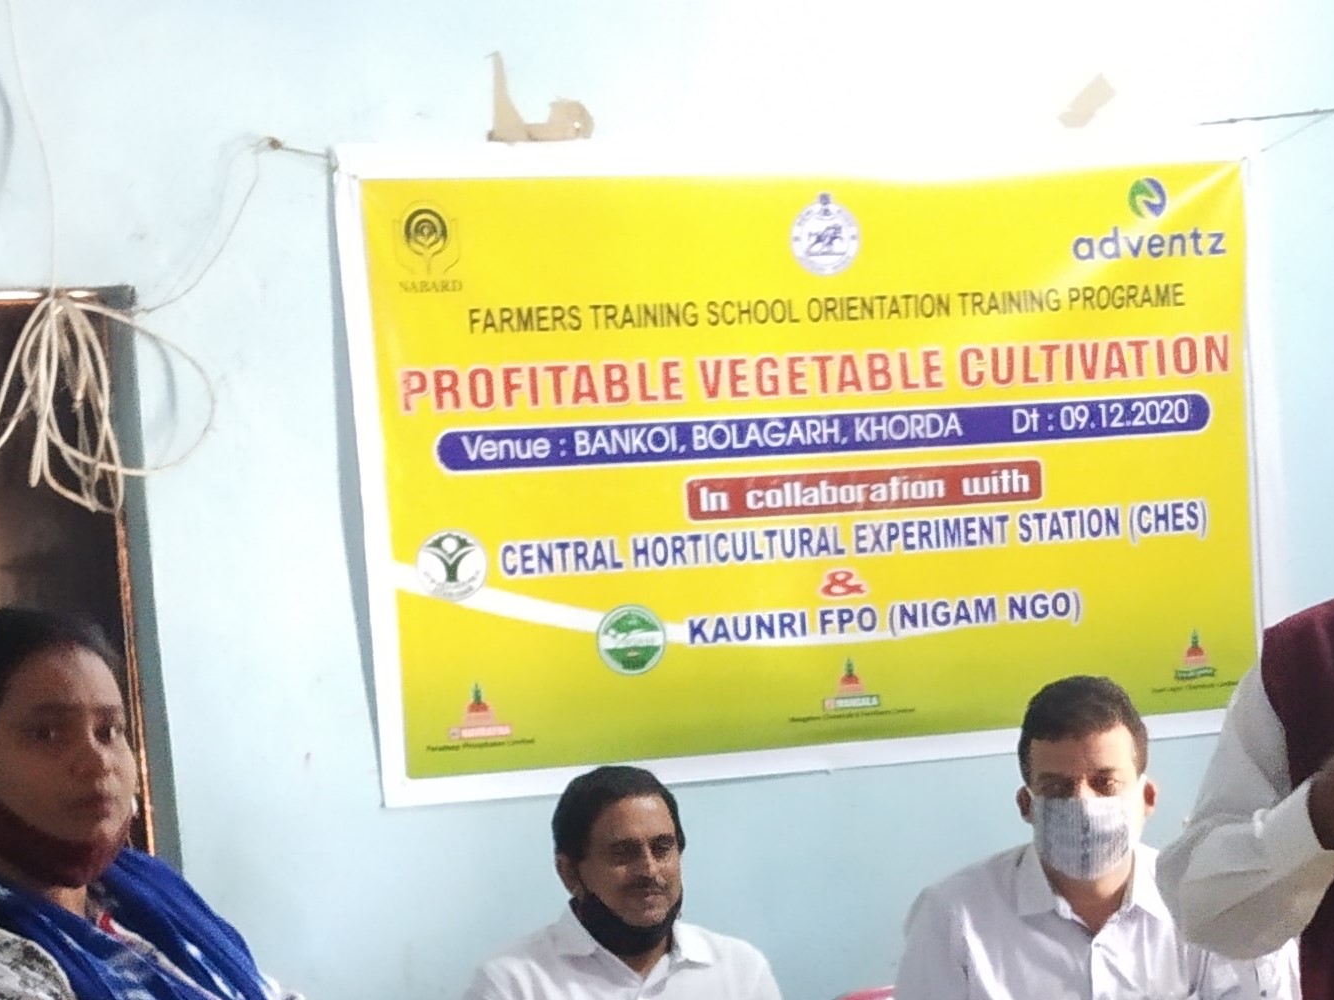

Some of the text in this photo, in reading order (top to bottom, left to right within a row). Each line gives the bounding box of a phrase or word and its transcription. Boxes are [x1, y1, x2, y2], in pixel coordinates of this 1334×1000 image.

[1072, 226, 1227, 262] adventz
[468, 282, 1186, 334] FARMERS TRAINING SCHOOL ORIENTATION TRAINING PROGRAME
[402, 334, 1230, 411] PROFITABLE VEGETABLE CULTIVATION
[461, 434, 550, 462] Venue
[575, 427, 686, 458] BANKOI,
[693, 415, 848, 451] BOLAGARH,
[855, 412, 964, 444] KHORDA
[1013, 408, 1039, 434] Dt
[1060, 399, 1189, 431] 09.12.2020
[699, 468, 1030, 513] In collaboration with
[501, 500, 1208, 576] CENTRAL HORTICULTURAL EXPERIMENT STATION (CHES)
[820, 569, 867, 597] &
[687, 590, 1082, 645] KAUNRI FPO (NIGAM NGO)
